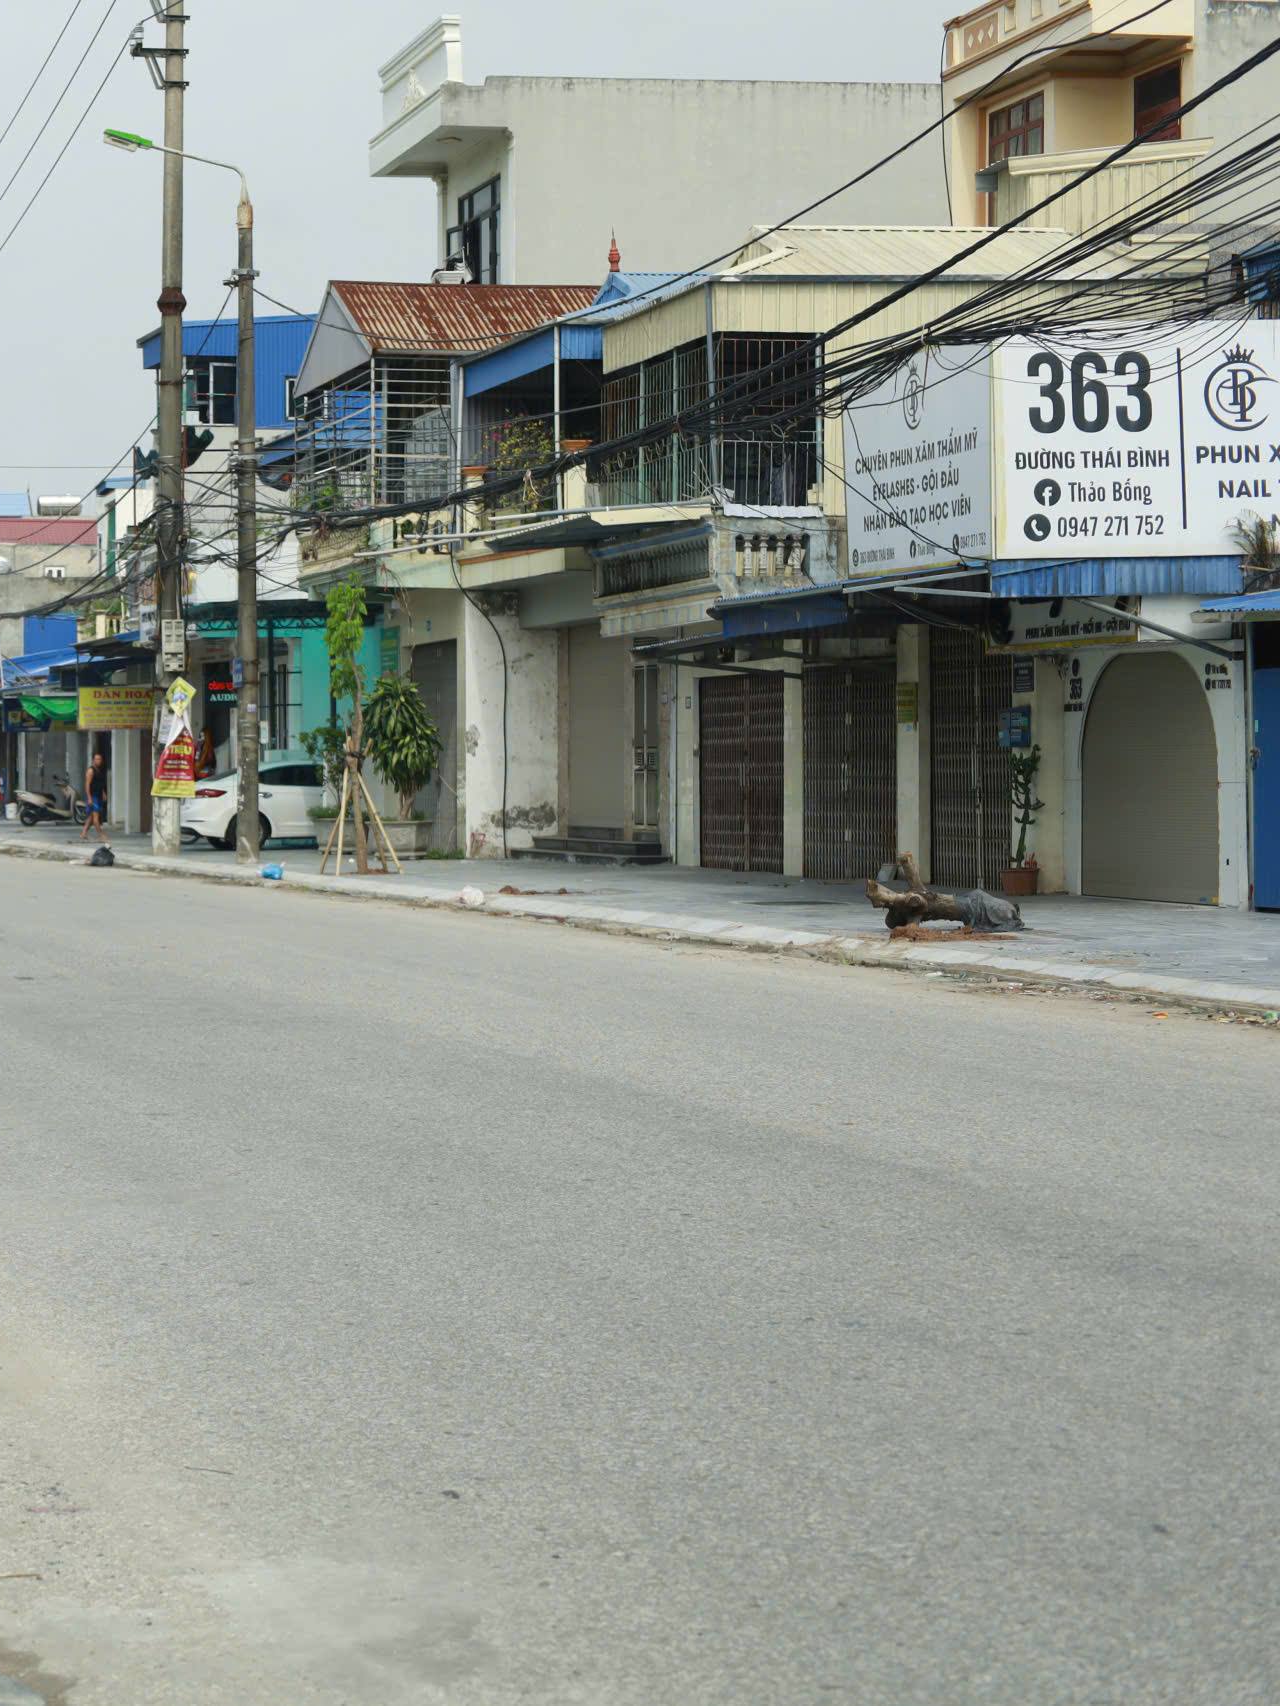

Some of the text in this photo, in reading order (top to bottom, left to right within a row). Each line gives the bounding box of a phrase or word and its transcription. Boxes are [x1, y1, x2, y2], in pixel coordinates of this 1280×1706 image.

[1027, 351, 1152, 433] 363
[855, 450, 888, 475] CHUYÊN
[890, 448, 913, 467] PHUN
[915, 440, 935, 463] XĂM
[1015, 446, 1169, 470] ĐƯỜNG THÁI BÌNH
[1196, 445, 1260, 464] PHUN
[872, 478, 915, 501] EYELASHES
[1068, 478, 1153, 505] Thảo Bống
[1218, 479, 1272, 499] NAIL
[863, 510, 887, 535] NHẬN
[910, 506, 927, 529] TẠO
[929, 502, 949, 526] HỌC
[952, 493, 971, 517] VIÊN
[1057, 514, 1164, 537] 0947 271 752
